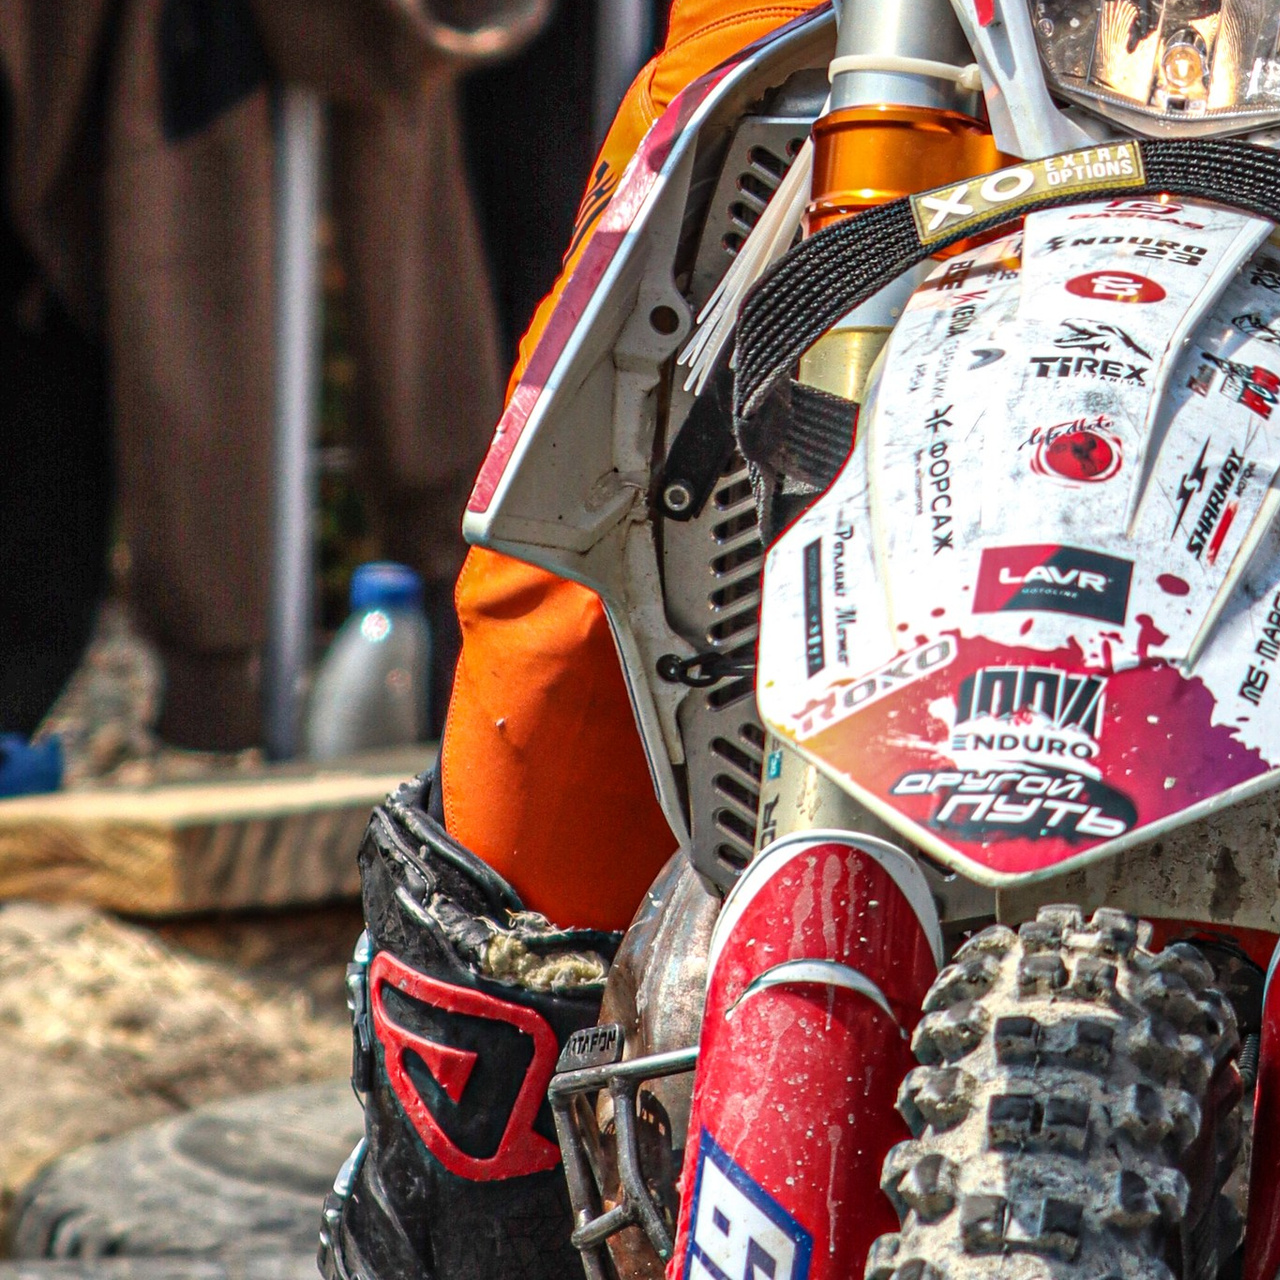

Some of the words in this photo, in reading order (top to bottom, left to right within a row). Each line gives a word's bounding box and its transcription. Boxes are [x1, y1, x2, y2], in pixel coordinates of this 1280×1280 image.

[1043, 144, 1131, 172] EXTRA
[1046, 158, 1135, 186] OPTIONS
[920, 166, 1036, 233] XO
[945, 303, 977, 338] KENDA
[1029, 356, 1150, 383] TIREX
[929, 440, 954, 557] ФОРСАЖ
[1186, 446, 1245, 561] SHARMAX
[998, 565, 1106, 593] LAVR
[951, 733, 1094, 760] ENDURO
[936, 793, 1127, 839] ПУТЬ
